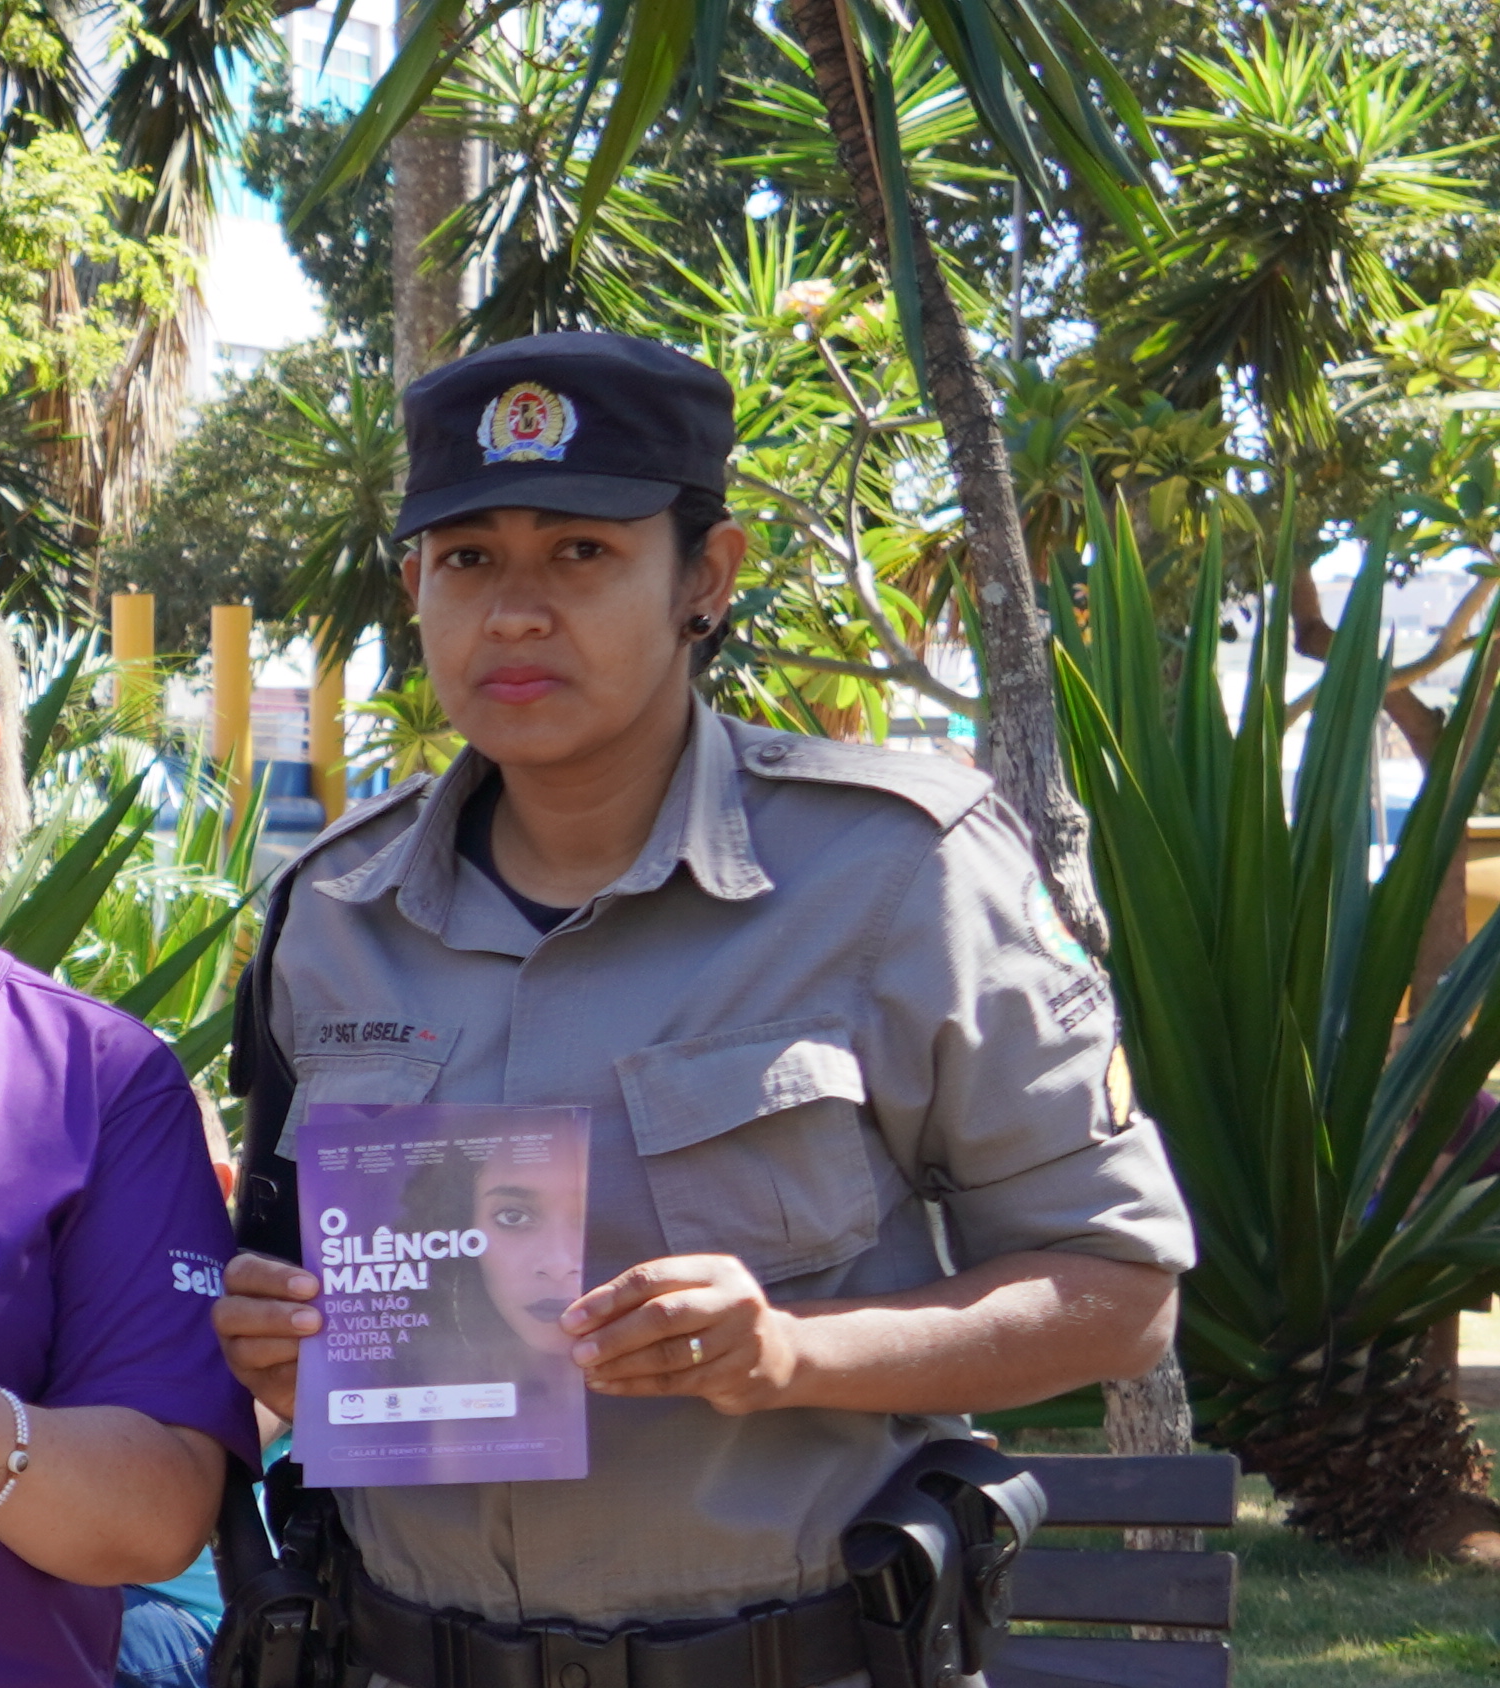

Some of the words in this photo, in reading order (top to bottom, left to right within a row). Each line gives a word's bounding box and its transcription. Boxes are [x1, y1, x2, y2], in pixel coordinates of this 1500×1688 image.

[362, 1021, 416, 1043] GISELE
[319, 1207, 347, 1236] O
[321, 1225, 488, 1266] SILÊNCIO
[172, 1261, 225, 1298] Seli
[323, 1261, 429, 1295] MATA!
[325, 1299, 365, 1314] DIGA
[371, 1295, 411, 1312] NÃO
[327, 1315, 338, 1331] À
[344, 1312, 430, 1330] VIOLÊNCIA
[327, 1331, 391, 1347] CONTRA
[396, 1330, 410, 1344] A
[327, 1346, 396, 1362] MULHER.
